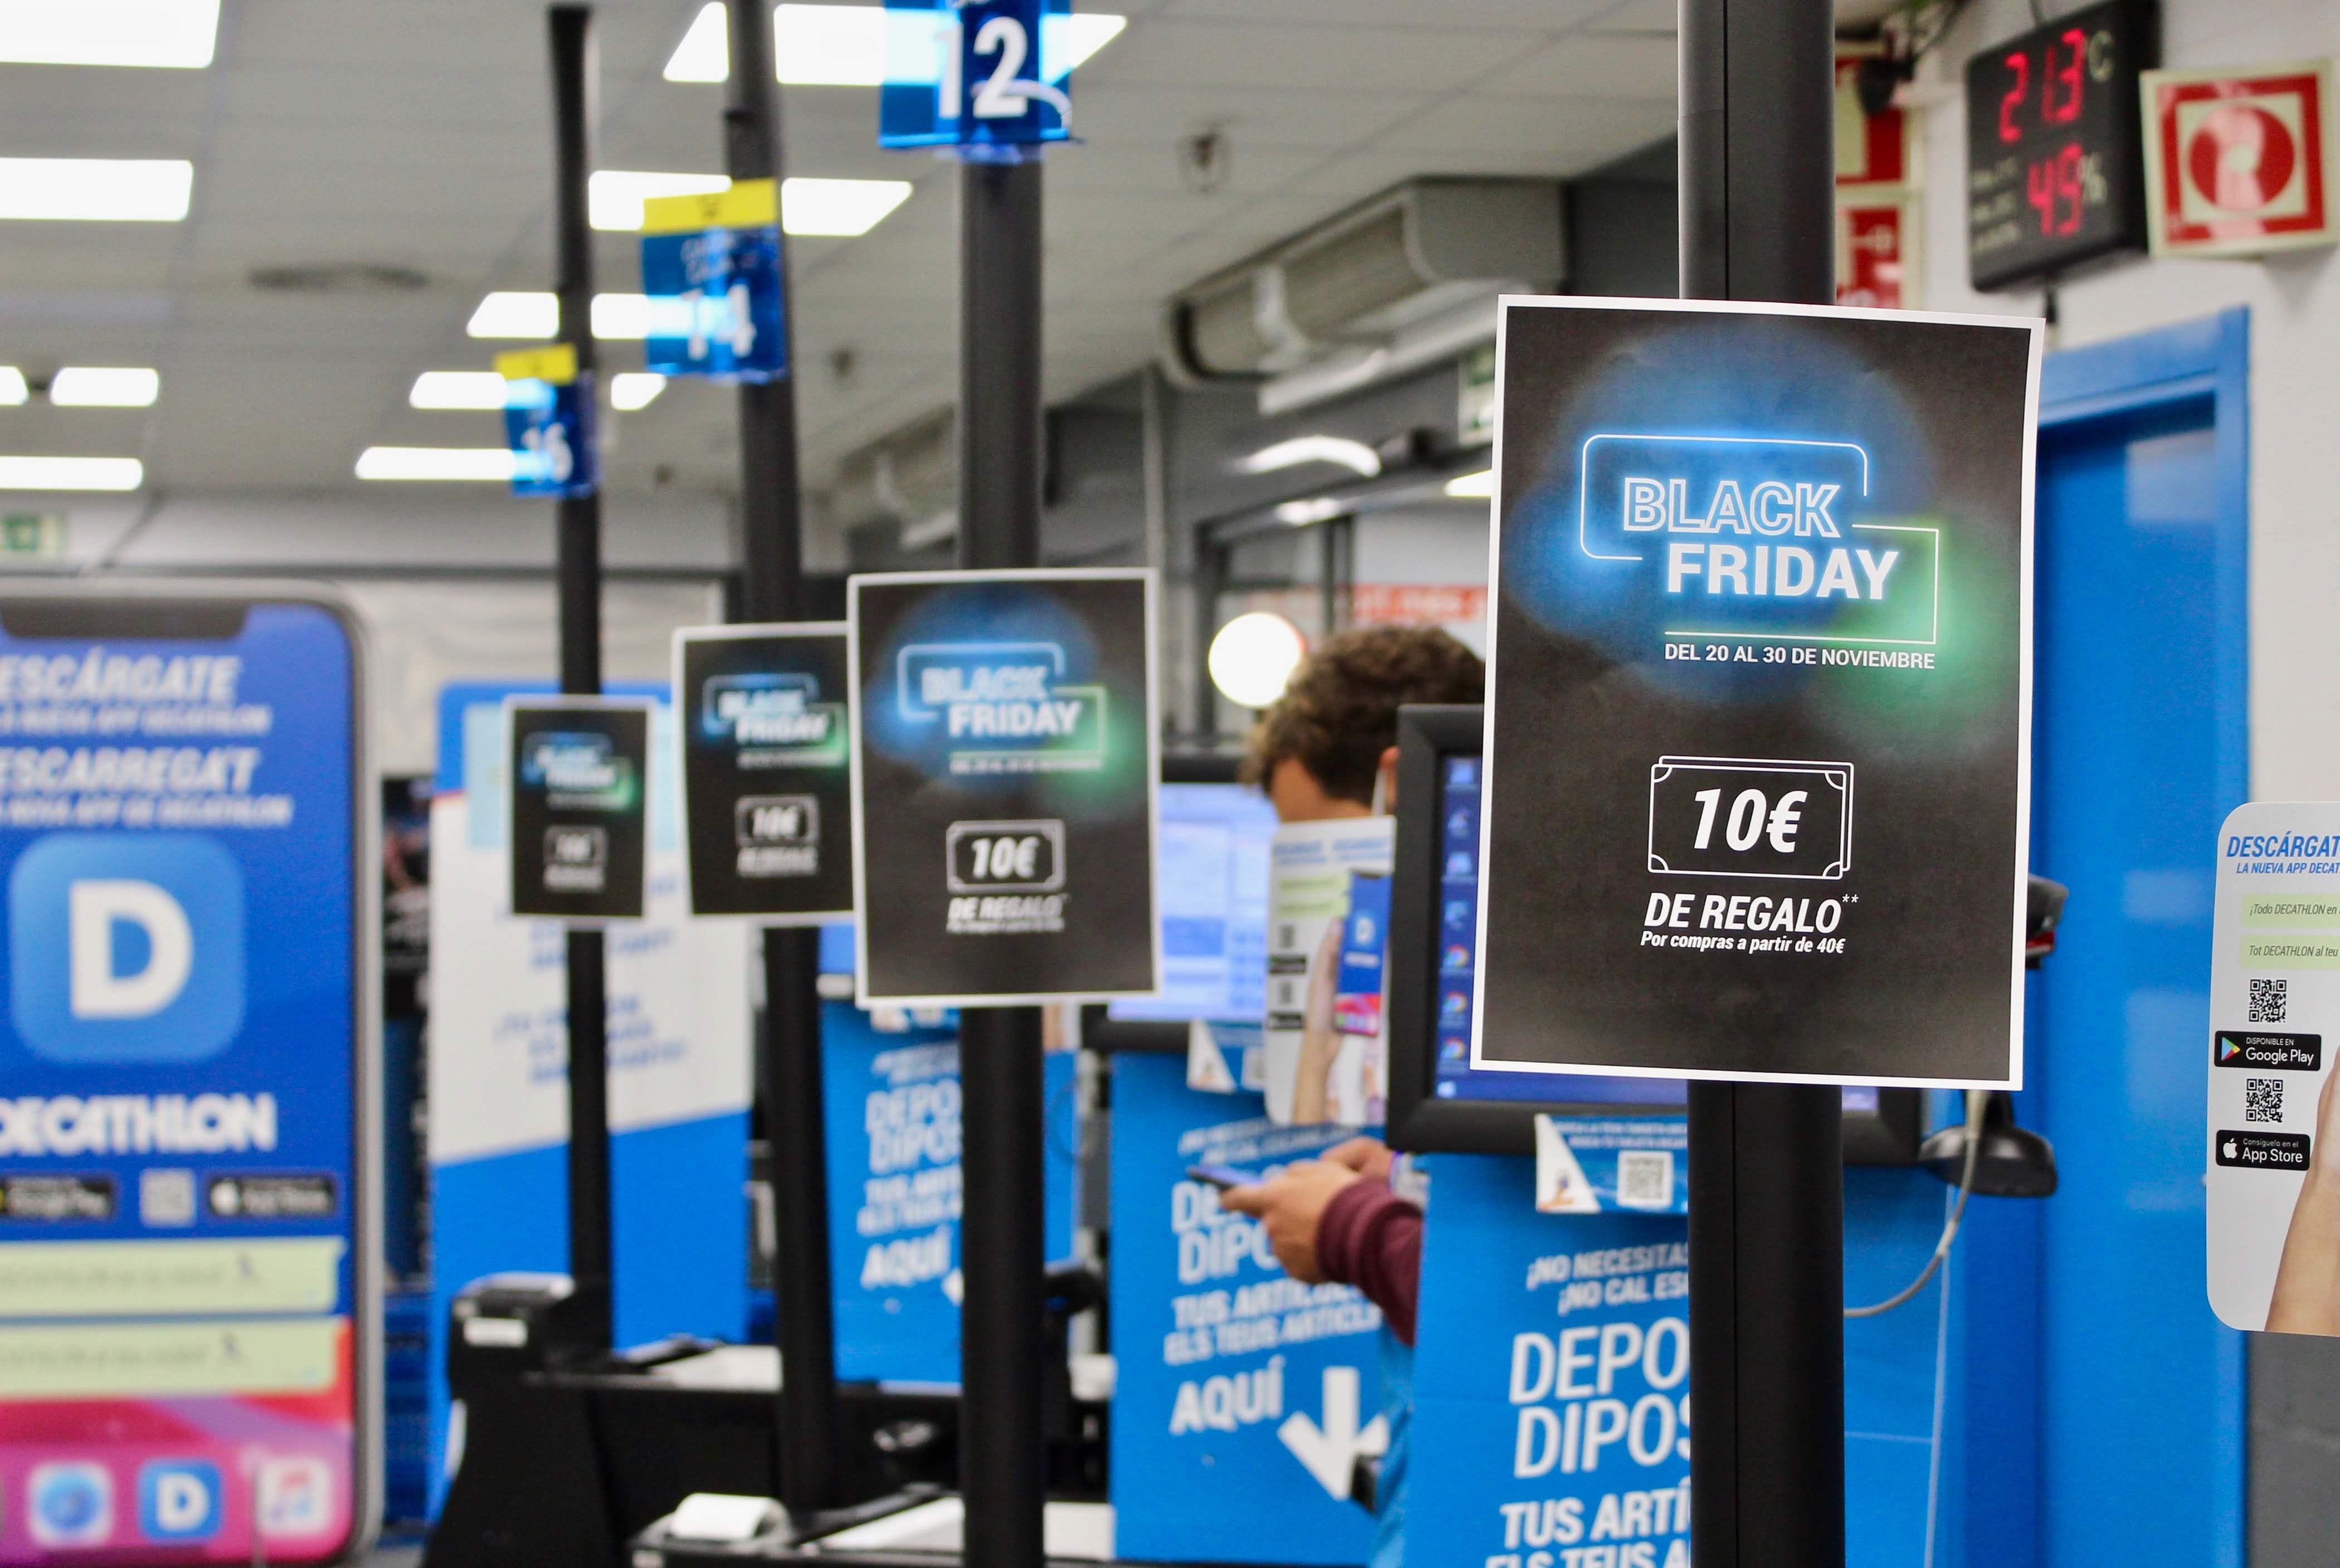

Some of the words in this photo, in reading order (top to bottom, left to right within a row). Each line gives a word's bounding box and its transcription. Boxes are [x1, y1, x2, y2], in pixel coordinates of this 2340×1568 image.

[933, 16, 1028, 119] 12
[1622, 477, 1841, 538] BLACK
[1667, 543, 1899, 600] FRIDAY
[1664, 642, 1701, 661] DEL
[1705, 644, 1729, 662] 20
[1733, 645, 1758, 663] AL
[1762, 646, 1787, 664] 30
[1791, 647, 1817, 665] DE
[1821, 649, 1935, 669] NOVIEMBRE
[948, 700, 1083, 737] FRIDAY
[1692, 787, 1808, 854] 10€
[971, 836, 1039, 880] 10€
[2226, 831, 2340, 858] DESCÁRGAT
[2236, 863, 2249, 874] LA
[2250, 863, 2284, 874] NUEVA
[2285, 863, 2307, 874] APP
[1643, 892, 1696, 928] DE
[2249, 904, 2273, 916] ¡Todo
[2274, 904, 2326, 914] DECATHLON
[2327, 906, 2337, 915] en
[68, 876, 196, 1022] D
[1640, 930, 1668, 947] Por
[1670, 934, 1734, 952] compras
[1737, 938, 1747, 950] a
[1749, 935, 1792, 955] partir
[1794, 936, 1813, 953] de
[1816, 937, 1846, 954] 40€
[2249, 946, 2263, 956] Tot
[2263, 946, 2314, 957] DECATHLON
[2315, 946, 2324, 957] al
[2325, 947, 2338, 957] teu
[2245, 1046, 2288, 1065] Google
[2290, 1049, 2314, 1066] Play
[2246, 1037, 2284, 1046] DISPONIBLE
[2242, 1147, 2267, 1163] App
[2270, 1148, 2303, 1163] Store
[1573, 1241, 1689, 1279] NECESITA
[1654, 1272, 1689, 1301] ES
[1508, 1316, 1690, 1405] DEPO
[1168, 1354, 1286, 1436] AQUÍ
[1500, 1496, 1585, 1550] TUS
